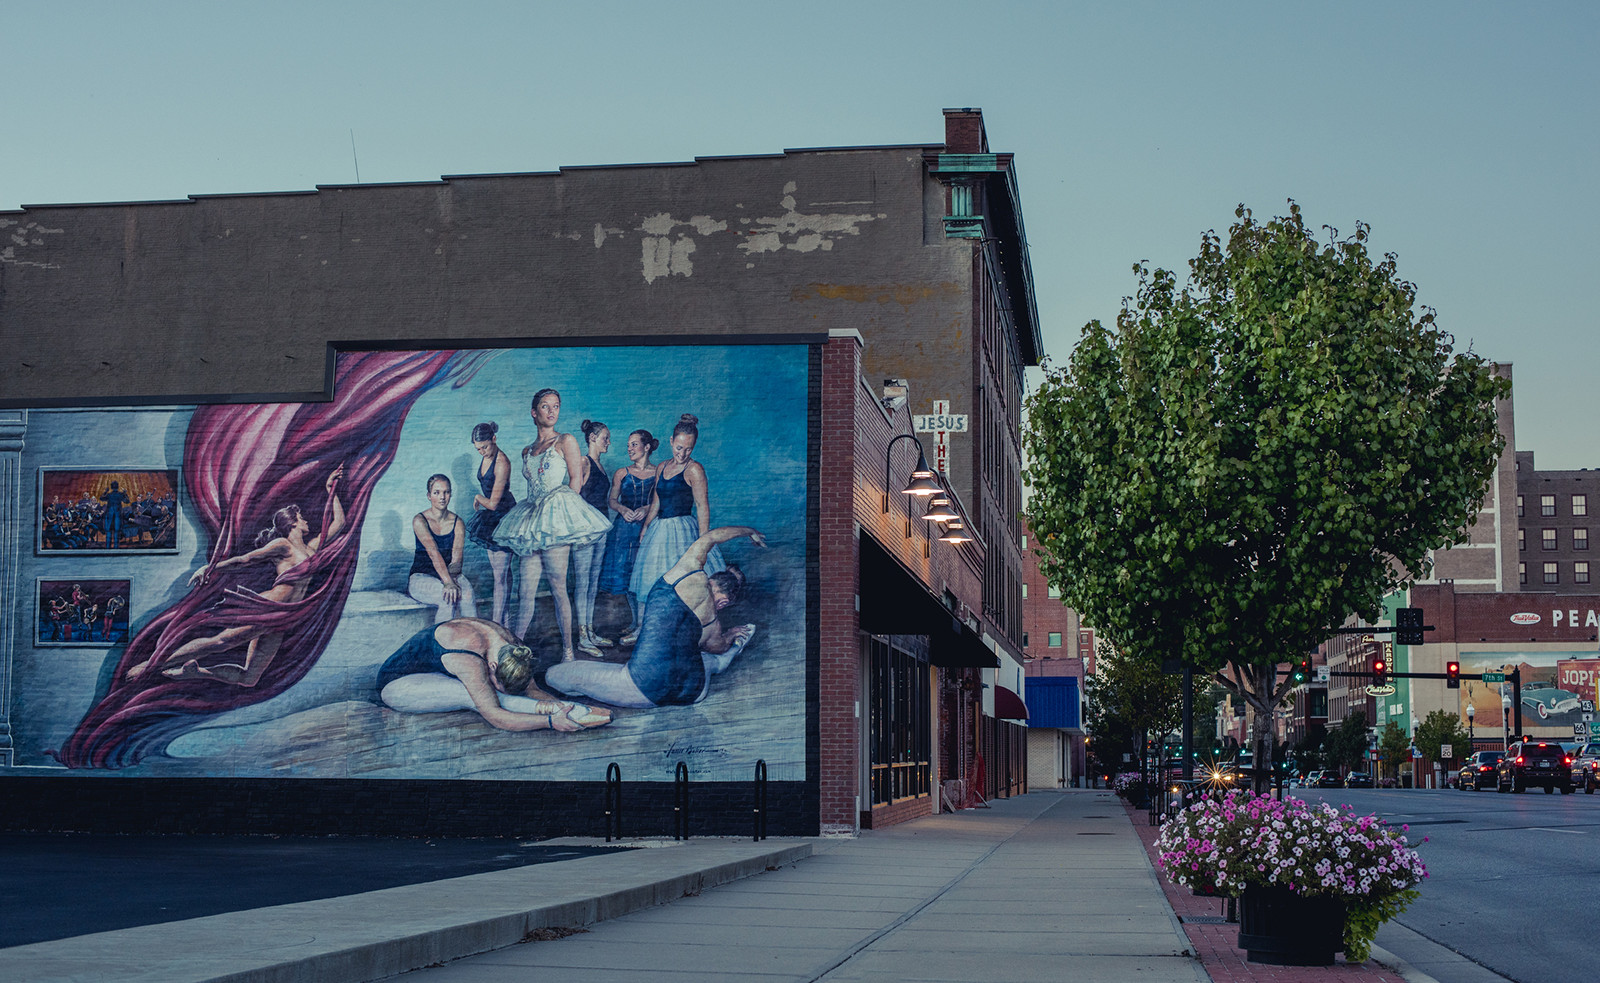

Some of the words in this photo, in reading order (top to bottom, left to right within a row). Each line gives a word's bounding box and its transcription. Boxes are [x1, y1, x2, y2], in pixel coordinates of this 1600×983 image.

[919, 415, 963, 430] JESUS
[937, 431, 946, 471] THE
[1385, 643, 1393, 681] HARDWAE
[1562, 670, 1600, 687] JOPL
[1576, 724, 1584, 732] 66
